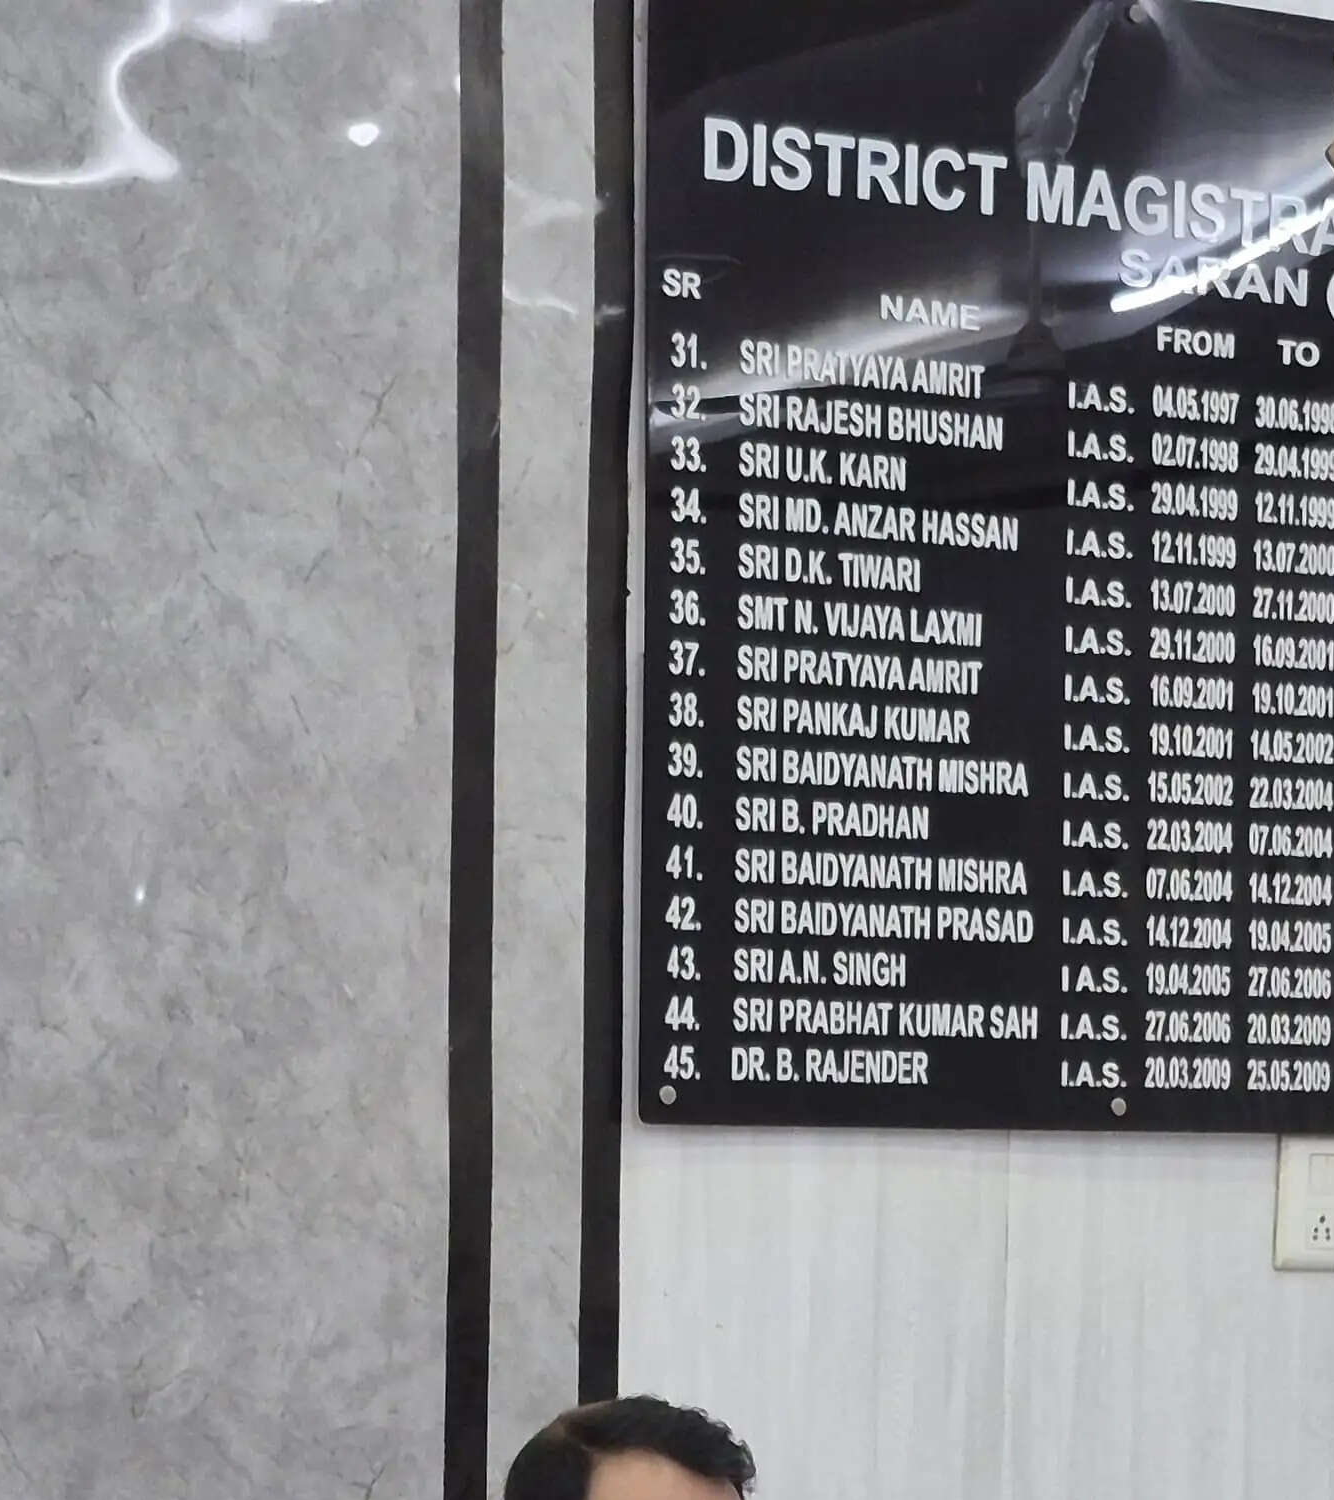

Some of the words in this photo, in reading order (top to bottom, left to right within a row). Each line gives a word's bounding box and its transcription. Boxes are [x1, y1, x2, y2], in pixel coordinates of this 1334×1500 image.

[702, 116, 1008, 217] DISTRICT
[1118, 248, 1309, 307] SARAN
[661, 268, 702, 300] SR
[879, 293, 980, 333] NAME
[1157, 325, 1235, 359] FROM
[1277, 338, 1320, 368] TO
[670, 331, 708, 370] 31.
[740, 339, 779, 377] SRI
[787, 345, 905, 392] PRATYAYA
[911, 360, 986, 399] AMRIT
[1068, 381, 1135, 414] I.A.S.
[1152, 384, 1240, 425] 04.05.1997
[670, 382, 706, 425] 32.
[739, 392, 780, 429] SRI
[786, 395, 882, 439] RAJESH
[887, 411, 1004, 451] BHUSHAN
[670, 434, 707, 473] 33.
[738, 440, 780, 480] SRI
[786, 445, 833, 485] U.K.
[839, 451, 907, 492] KARN
[670, 486, 707, 524] 34.
[738, 492, 780, 531] SRI
[785, 496, 829, 534] MD.
[833, 501, 916, 543] ANZAR
[922, 509, 1019, 552] HASSAN
[669, 536, 706, 575] 35.
[737, 542, 779, 581] SRI
[785, 547, 833, 585] D.K.
[837, 552, 921, 593] TIWARI
[669, 588, 706, 626] 36.
[737, 593, 789, 632] SMT
[794, 599, 819, 635] N.
[824, 601, 905, 642] VIJAYA
[910, 607, 983, 648] LAXMI
[668, 639, 706, 677] 37.
[737, 644, 778, 682] SRI
[783, 648, 906, 691] PRATYAYA
[907, 657, 983, 695] AMRIT
[668, 691, 704, 728] 38.
[736, 695, 777, 732] SRI
[783, 698, 878, 739] PANKAJ
[884, 705, 971, 745] KUMAR
[667, 741, 703, 779] 39.
[736, 745, 777, 782] SRI
[782, 749, 933, 792] BAIDYANATH
[938, 758, 1029, 798] MISHRA
[666, 793, 703, 830] 40.
[735, 796, 776, 832] SRI
[782, 798, 805, 834] B.
[812, 801, 929, 840] PRADHAN
[665, 844, 703, 881] 41.
[734, 847, 776, 884] SRI
[781, 850, 933, 891] BAIDYANATH
[938, 857, 1028, 896] MISHRA
[665, 895, 702, 931] 42.
[734, 897, 775, 934] SRI
[781, 900, 931, 940] BAIDYANATH
[937, 906, 1034, 943] PRASAD
[666, 945, 701, 981] 43.
[733, 947, 774, 983] SRI
[778, 949, 827, 985] A.N.
[833, 950, 906, 988] SINGH
[664, 995, 700, 1031] 44.
[732, 997, 774, 1033] SRI
[779, 998, 894, 1036] PRABHAT
[898, 1002, 985, 1038] KUMAR
[989, 1004, 1038, 1040] SAH
[663, 1044, 701, 1080] 45.
[731, 1046, 771, 1082] DR.
[776, 1047, 800, 1082] B.
[805, 1048, 929, 1085] RAJENDER
[1061, 1060, 1127, 1089] I.A.S.
[1144, 1056, 1231, 1091] 20.03.2009
[1247, 1058, 1331, 1093] 25.05.2009
